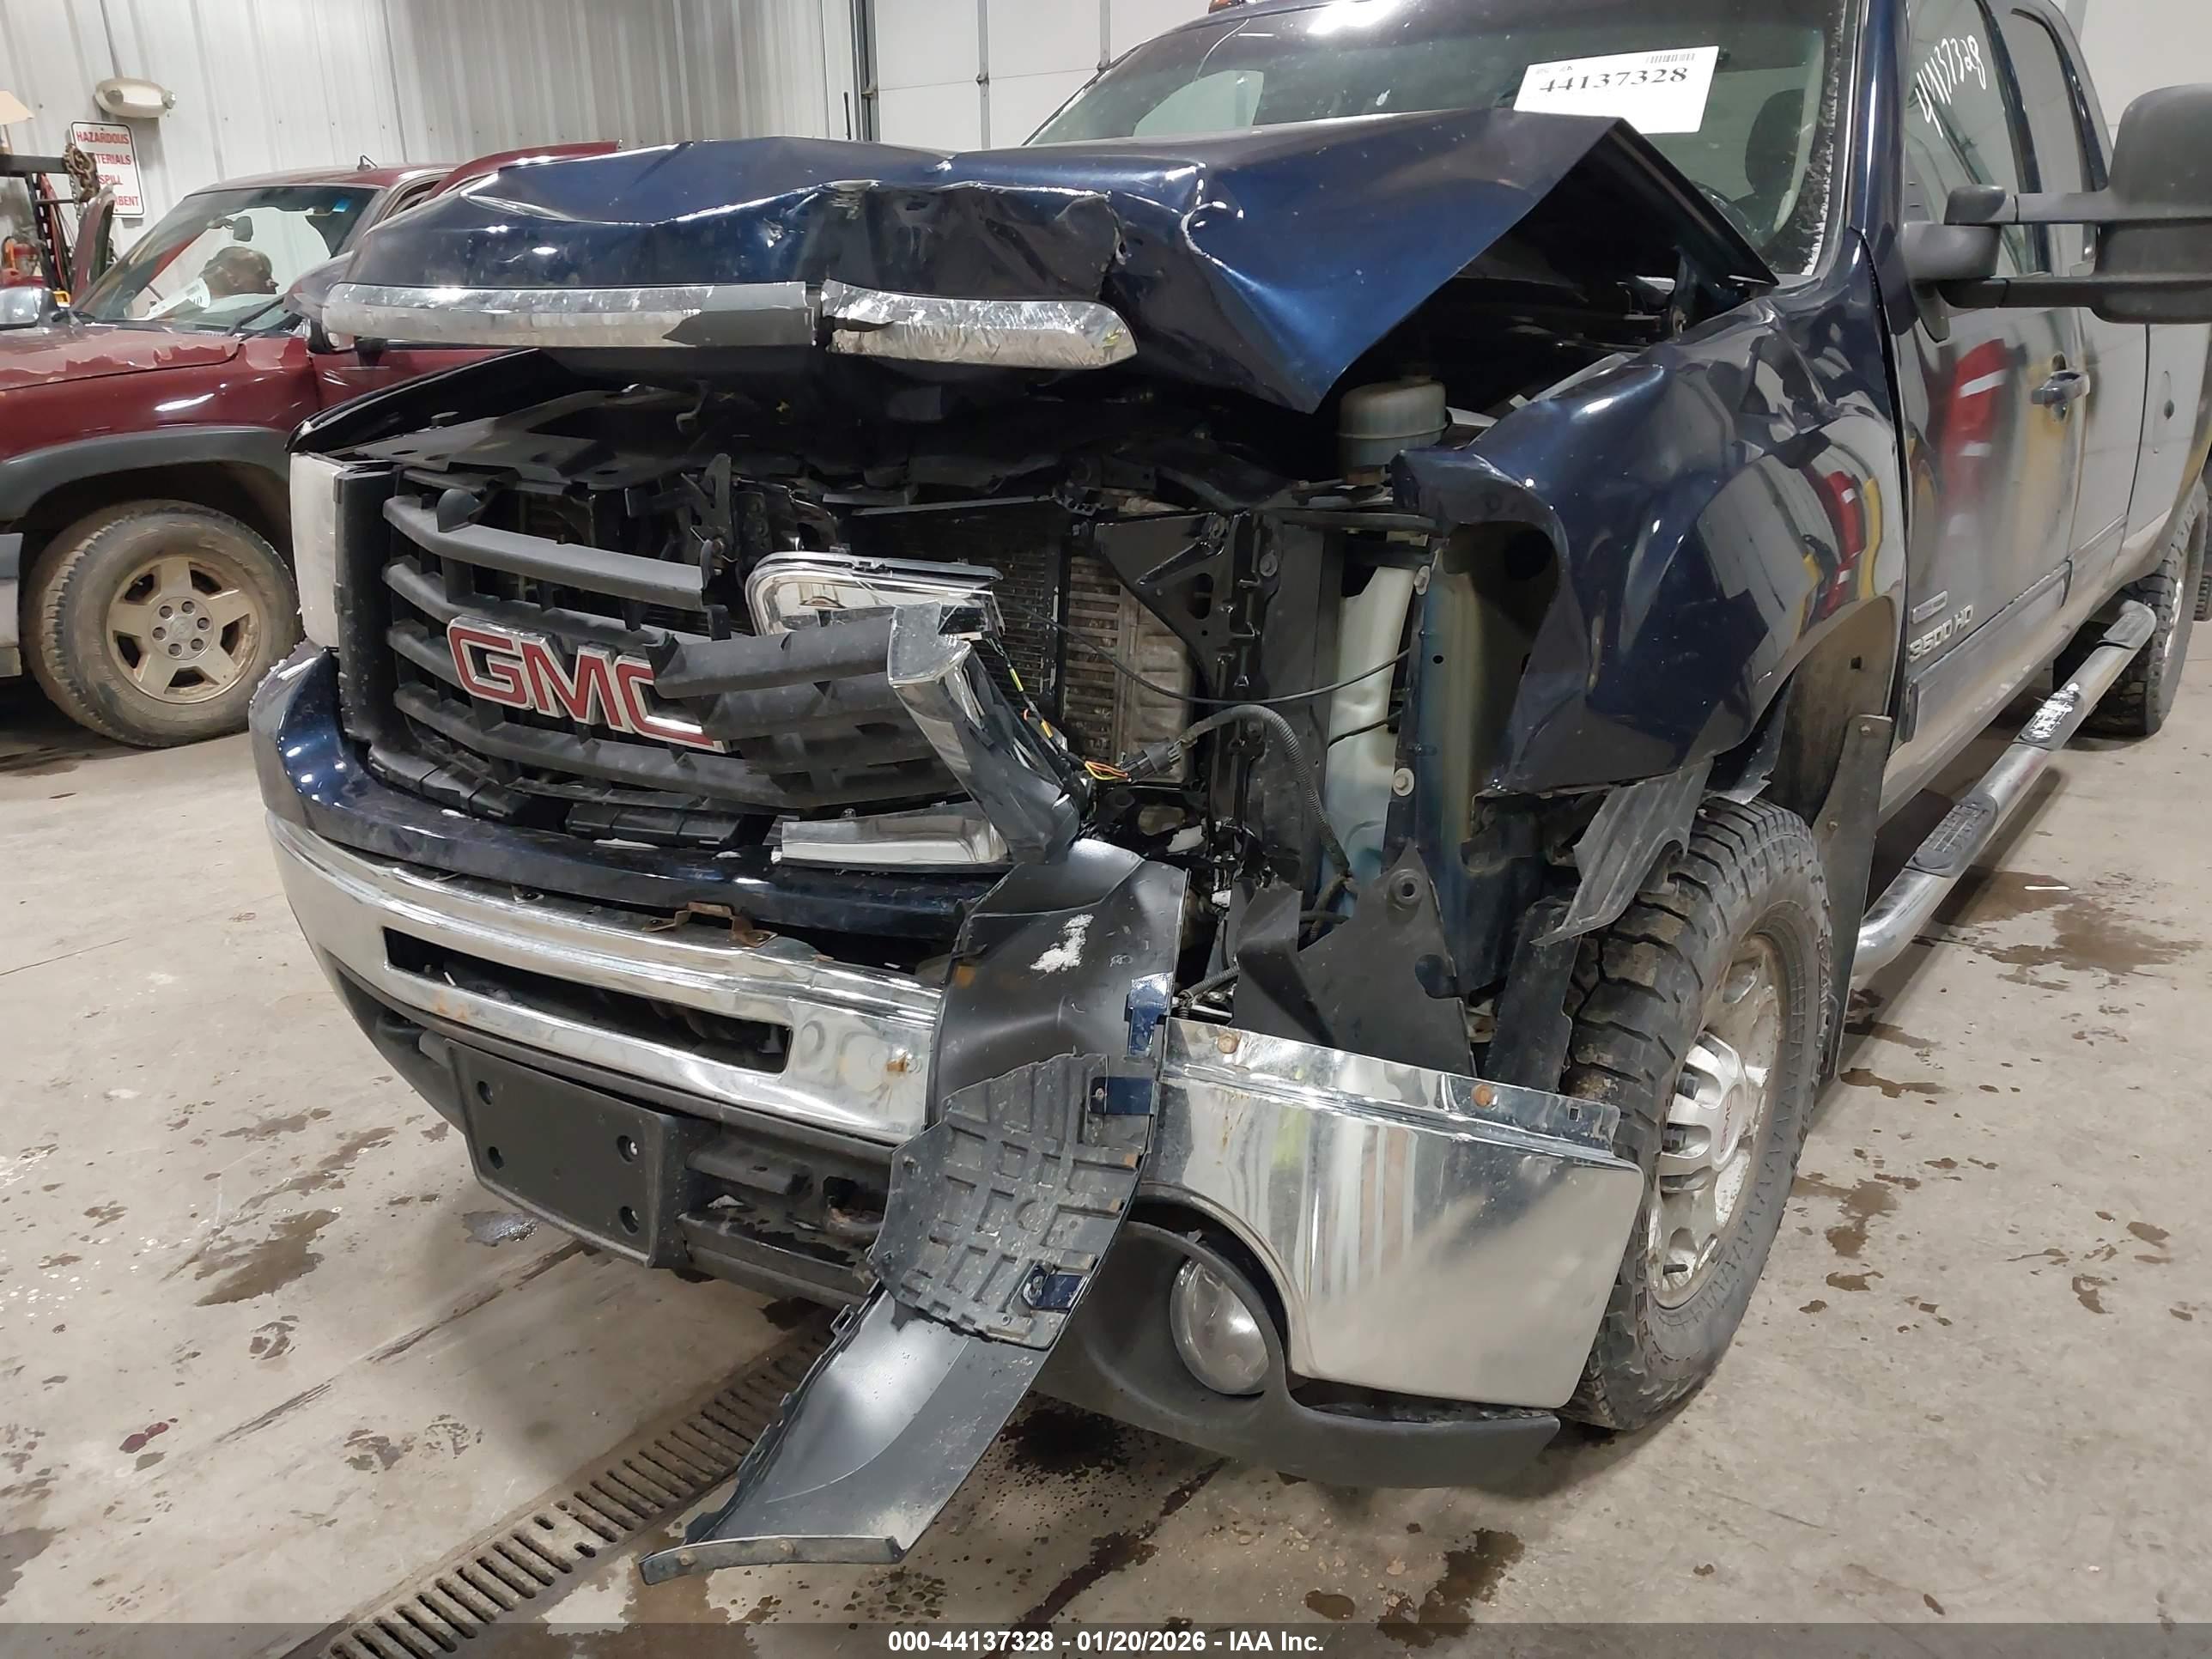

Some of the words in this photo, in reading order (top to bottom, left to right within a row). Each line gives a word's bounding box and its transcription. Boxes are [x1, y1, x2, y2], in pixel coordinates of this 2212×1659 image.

[1540, 68, 1688, 92] 44137328
[76, 131, 130, 144] HAZARDOUS
[95, 154, 131, 165] TERIALS
[99, 174, 124, 185] SPILL
[447, 614, 727, 753] GMC
